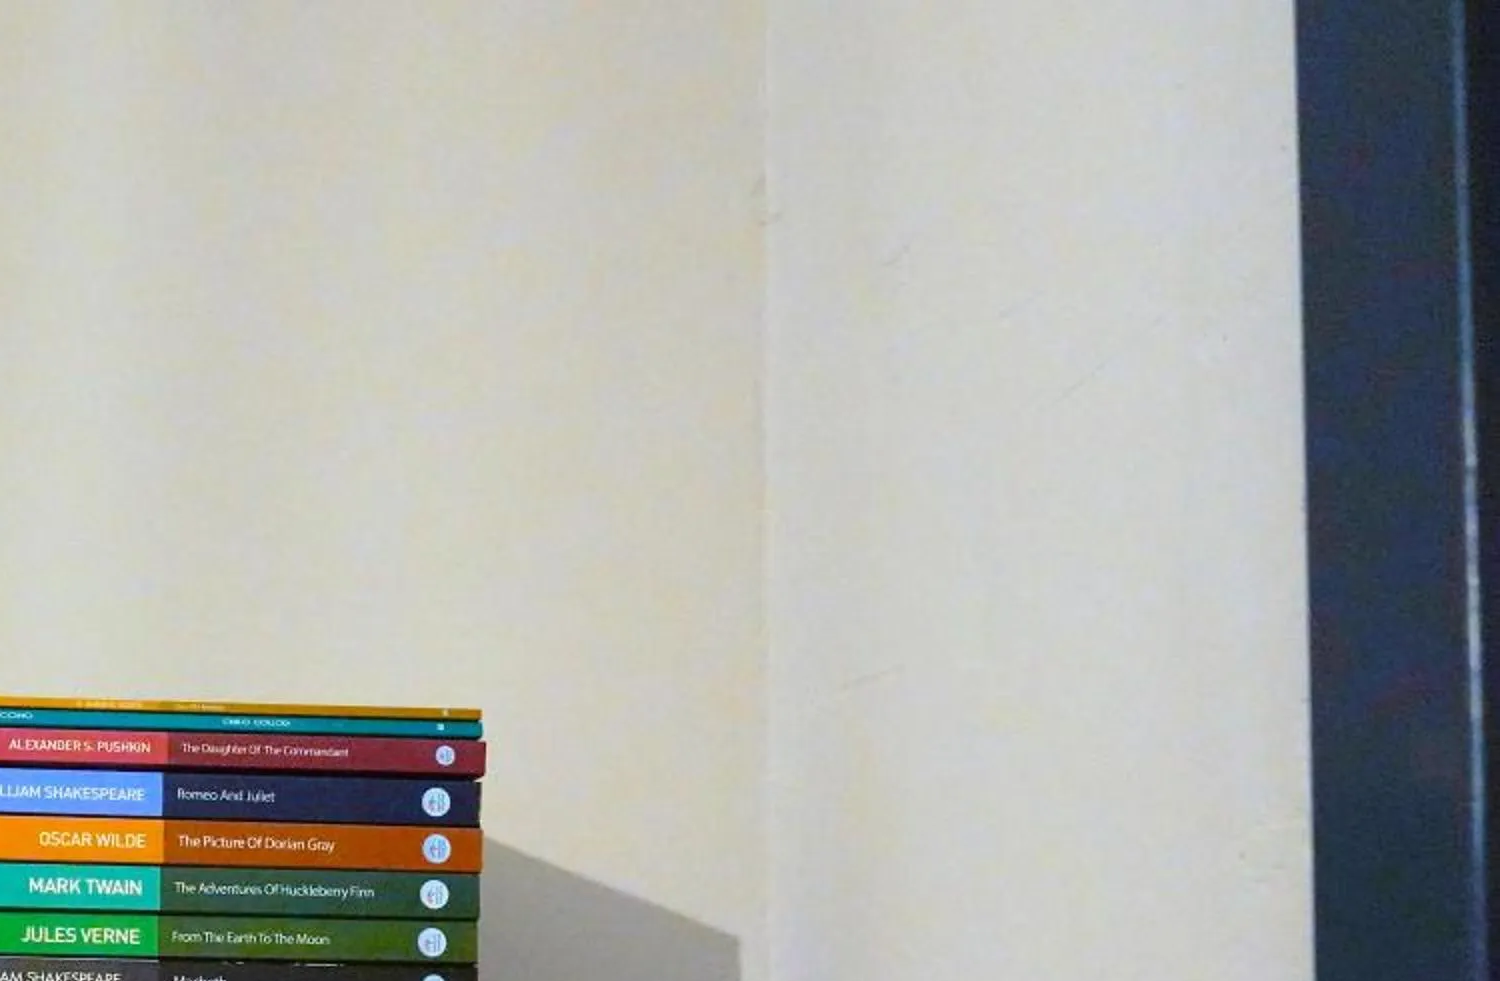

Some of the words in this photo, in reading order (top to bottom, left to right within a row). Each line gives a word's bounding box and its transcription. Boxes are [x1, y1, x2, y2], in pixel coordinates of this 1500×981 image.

[8, 738, 82, 752] ALEXANDER
[98, 740, 151, 754] PUSHKIN
[182, 743, 199, 753] The
[200, 743, 247, 758] Daughter
[248, 745, 261, 755] Of
[264, 745, 281, 756] The
[283, 746, 349, 758] Commandant
[44, 785, 146, 801] SHAKESPEARE
[177, 788, 219, 801] Romeo
[221, 788, 244, 802] And
[246, 789, 276, 803] Juliet
[39, 831, 92, 848] OSCAR
[95, 832, 146, 849] WILDE
[179, 835, 200, 847] The
[203, 835, 245, 849] Picture
[247, 837, 262, 849] Of
[264, 838, 305, 851] Dorian
[307, 839, 335, 855] Gray
[29, 878, 82, 894] MARK
[84, 879, 143, 896] TWAIN
[175, 882, 197, 894] The
[199, 883, 263, 896] Adventures
[264, 884, 279, 896] Of
[281, 885, 349, 901] Huckleberry
[351, 886, 375, 898] Finn
[20, 928, 77, 944] JULES
[81, 929, 141, 945] VERNE
[172, 931, 201, 943] From
[203, 931, 225, 943] The
[227, 932, 257, 944] Earth
[258, 932, 272, 944] To
[274, 933, 294, 945] The
[296, 933, 330, 945] Moon
